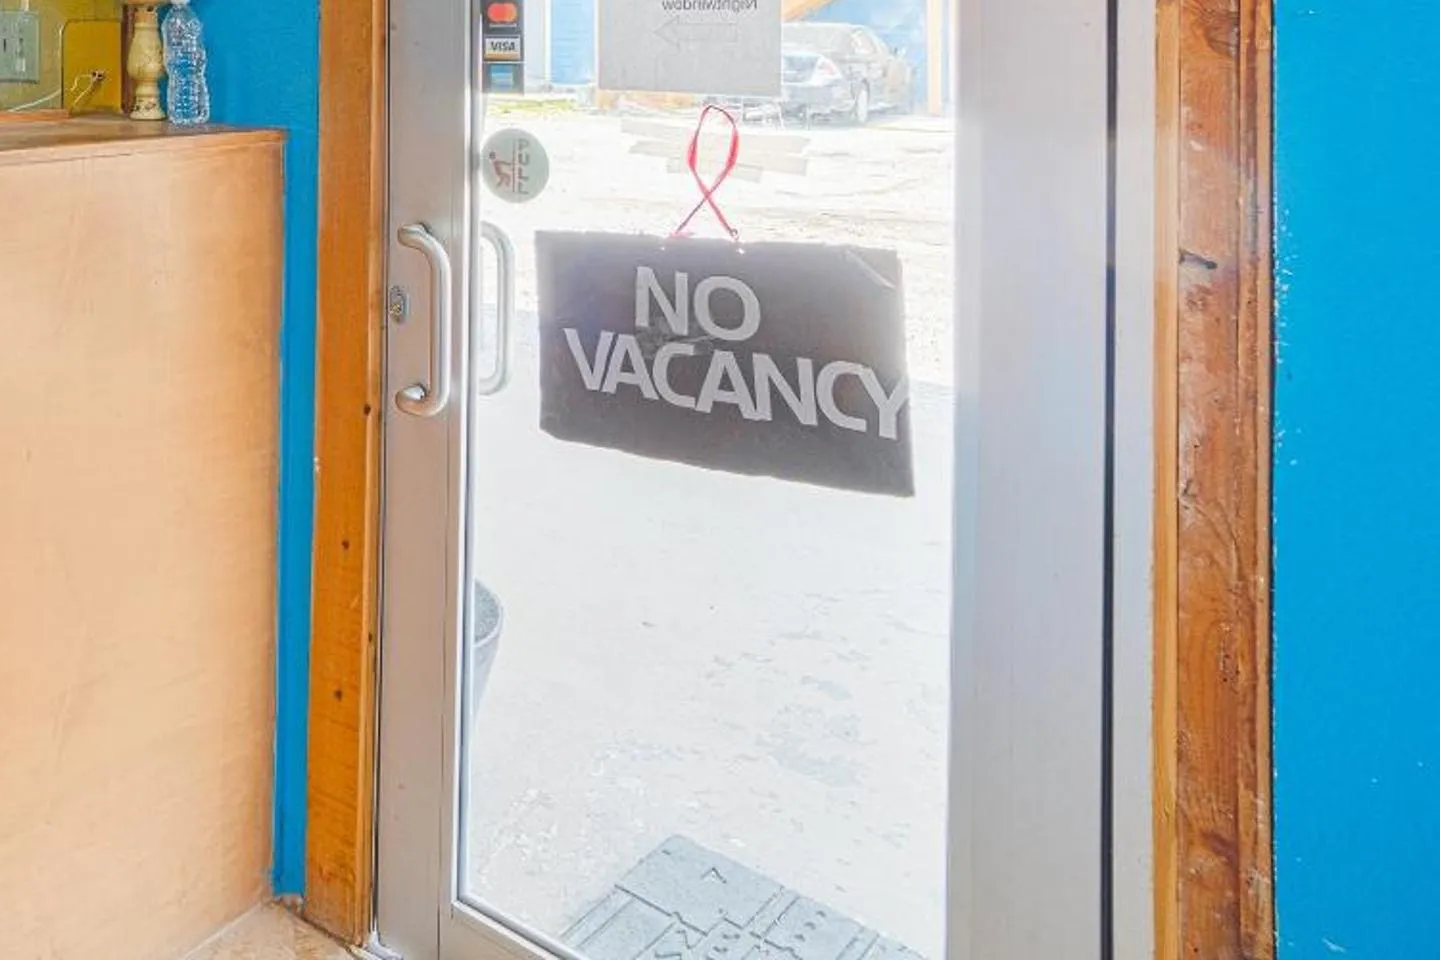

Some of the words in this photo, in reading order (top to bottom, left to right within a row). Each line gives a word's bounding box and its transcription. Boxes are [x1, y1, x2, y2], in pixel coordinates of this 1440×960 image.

[490, 41, 516, 52] VISA
[635, 266, 760, 341] NO
[563, 328, 910, 440] VACANCY
